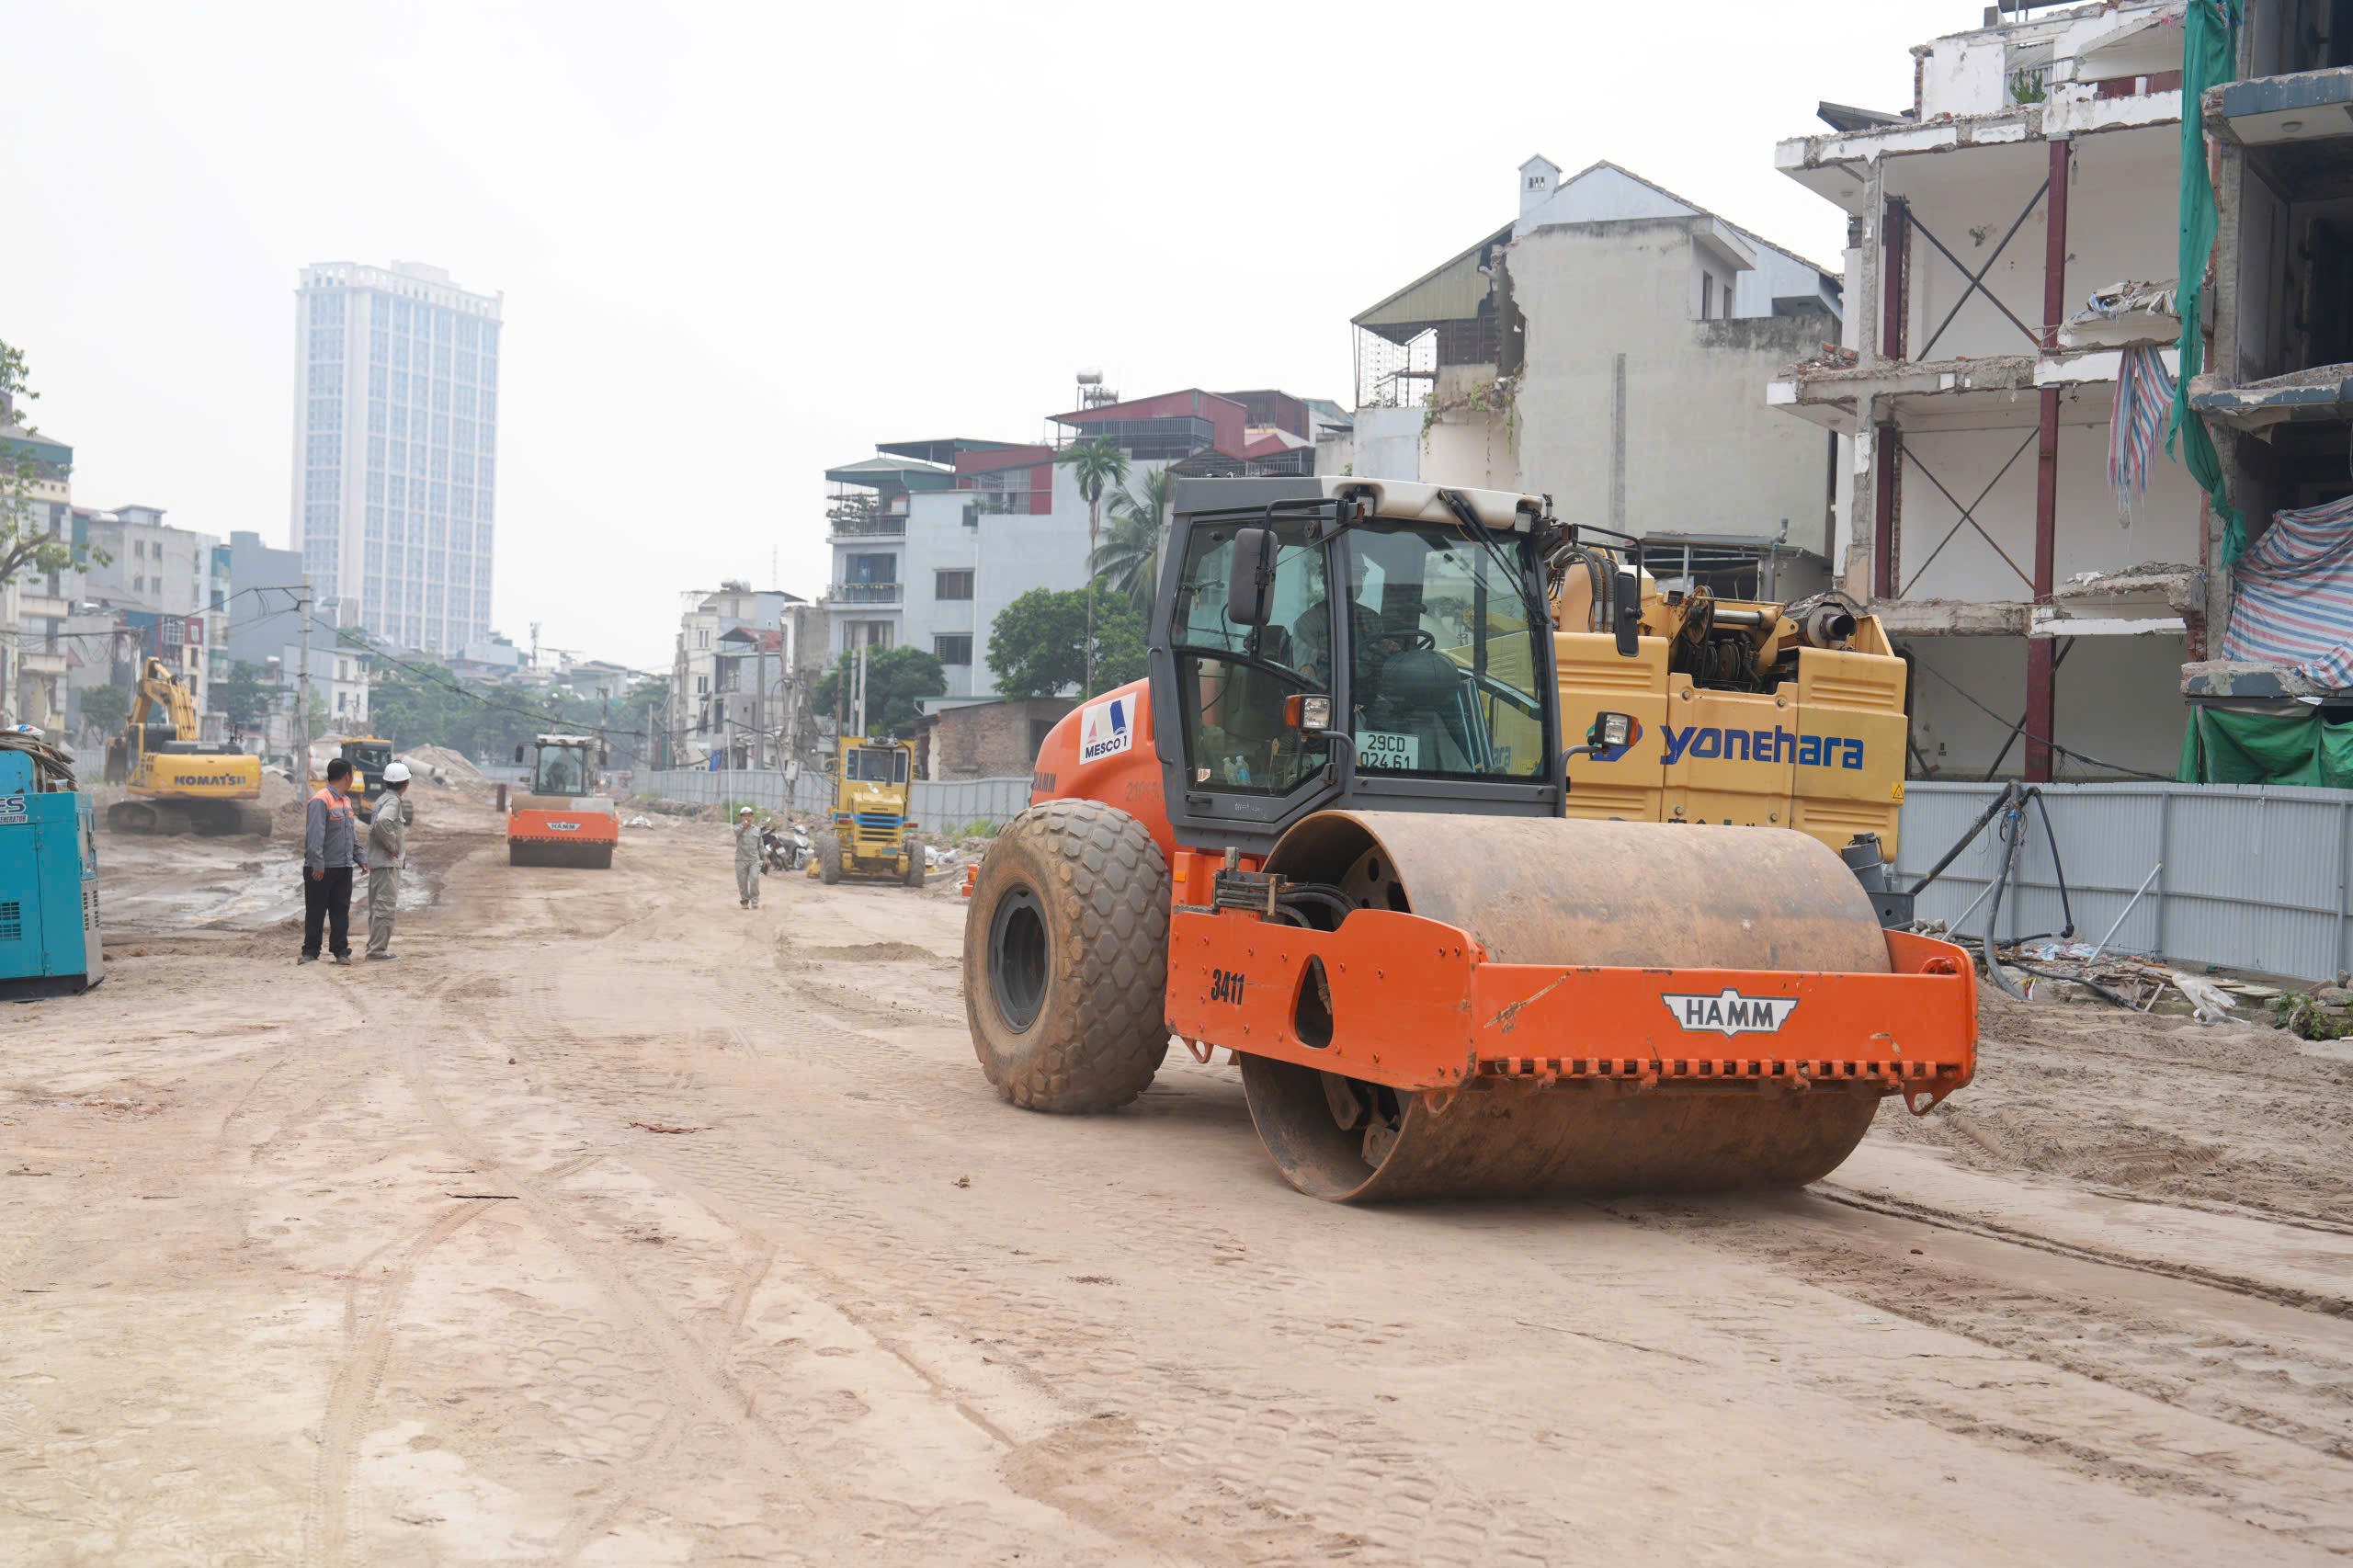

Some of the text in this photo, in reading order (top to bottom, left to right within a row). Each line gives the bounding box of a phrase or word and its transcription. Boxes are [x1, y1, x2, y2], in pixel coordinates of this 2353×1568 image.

[1086, 735, 1127, 758] MESCO 1
[1368, 734, 1405, 752] 29CD
[174, 774, 246, 786] KOMATSU
[1211, 969, 1245, 1006] 3411
[1686, 999, 1773, 1028] HAMM
